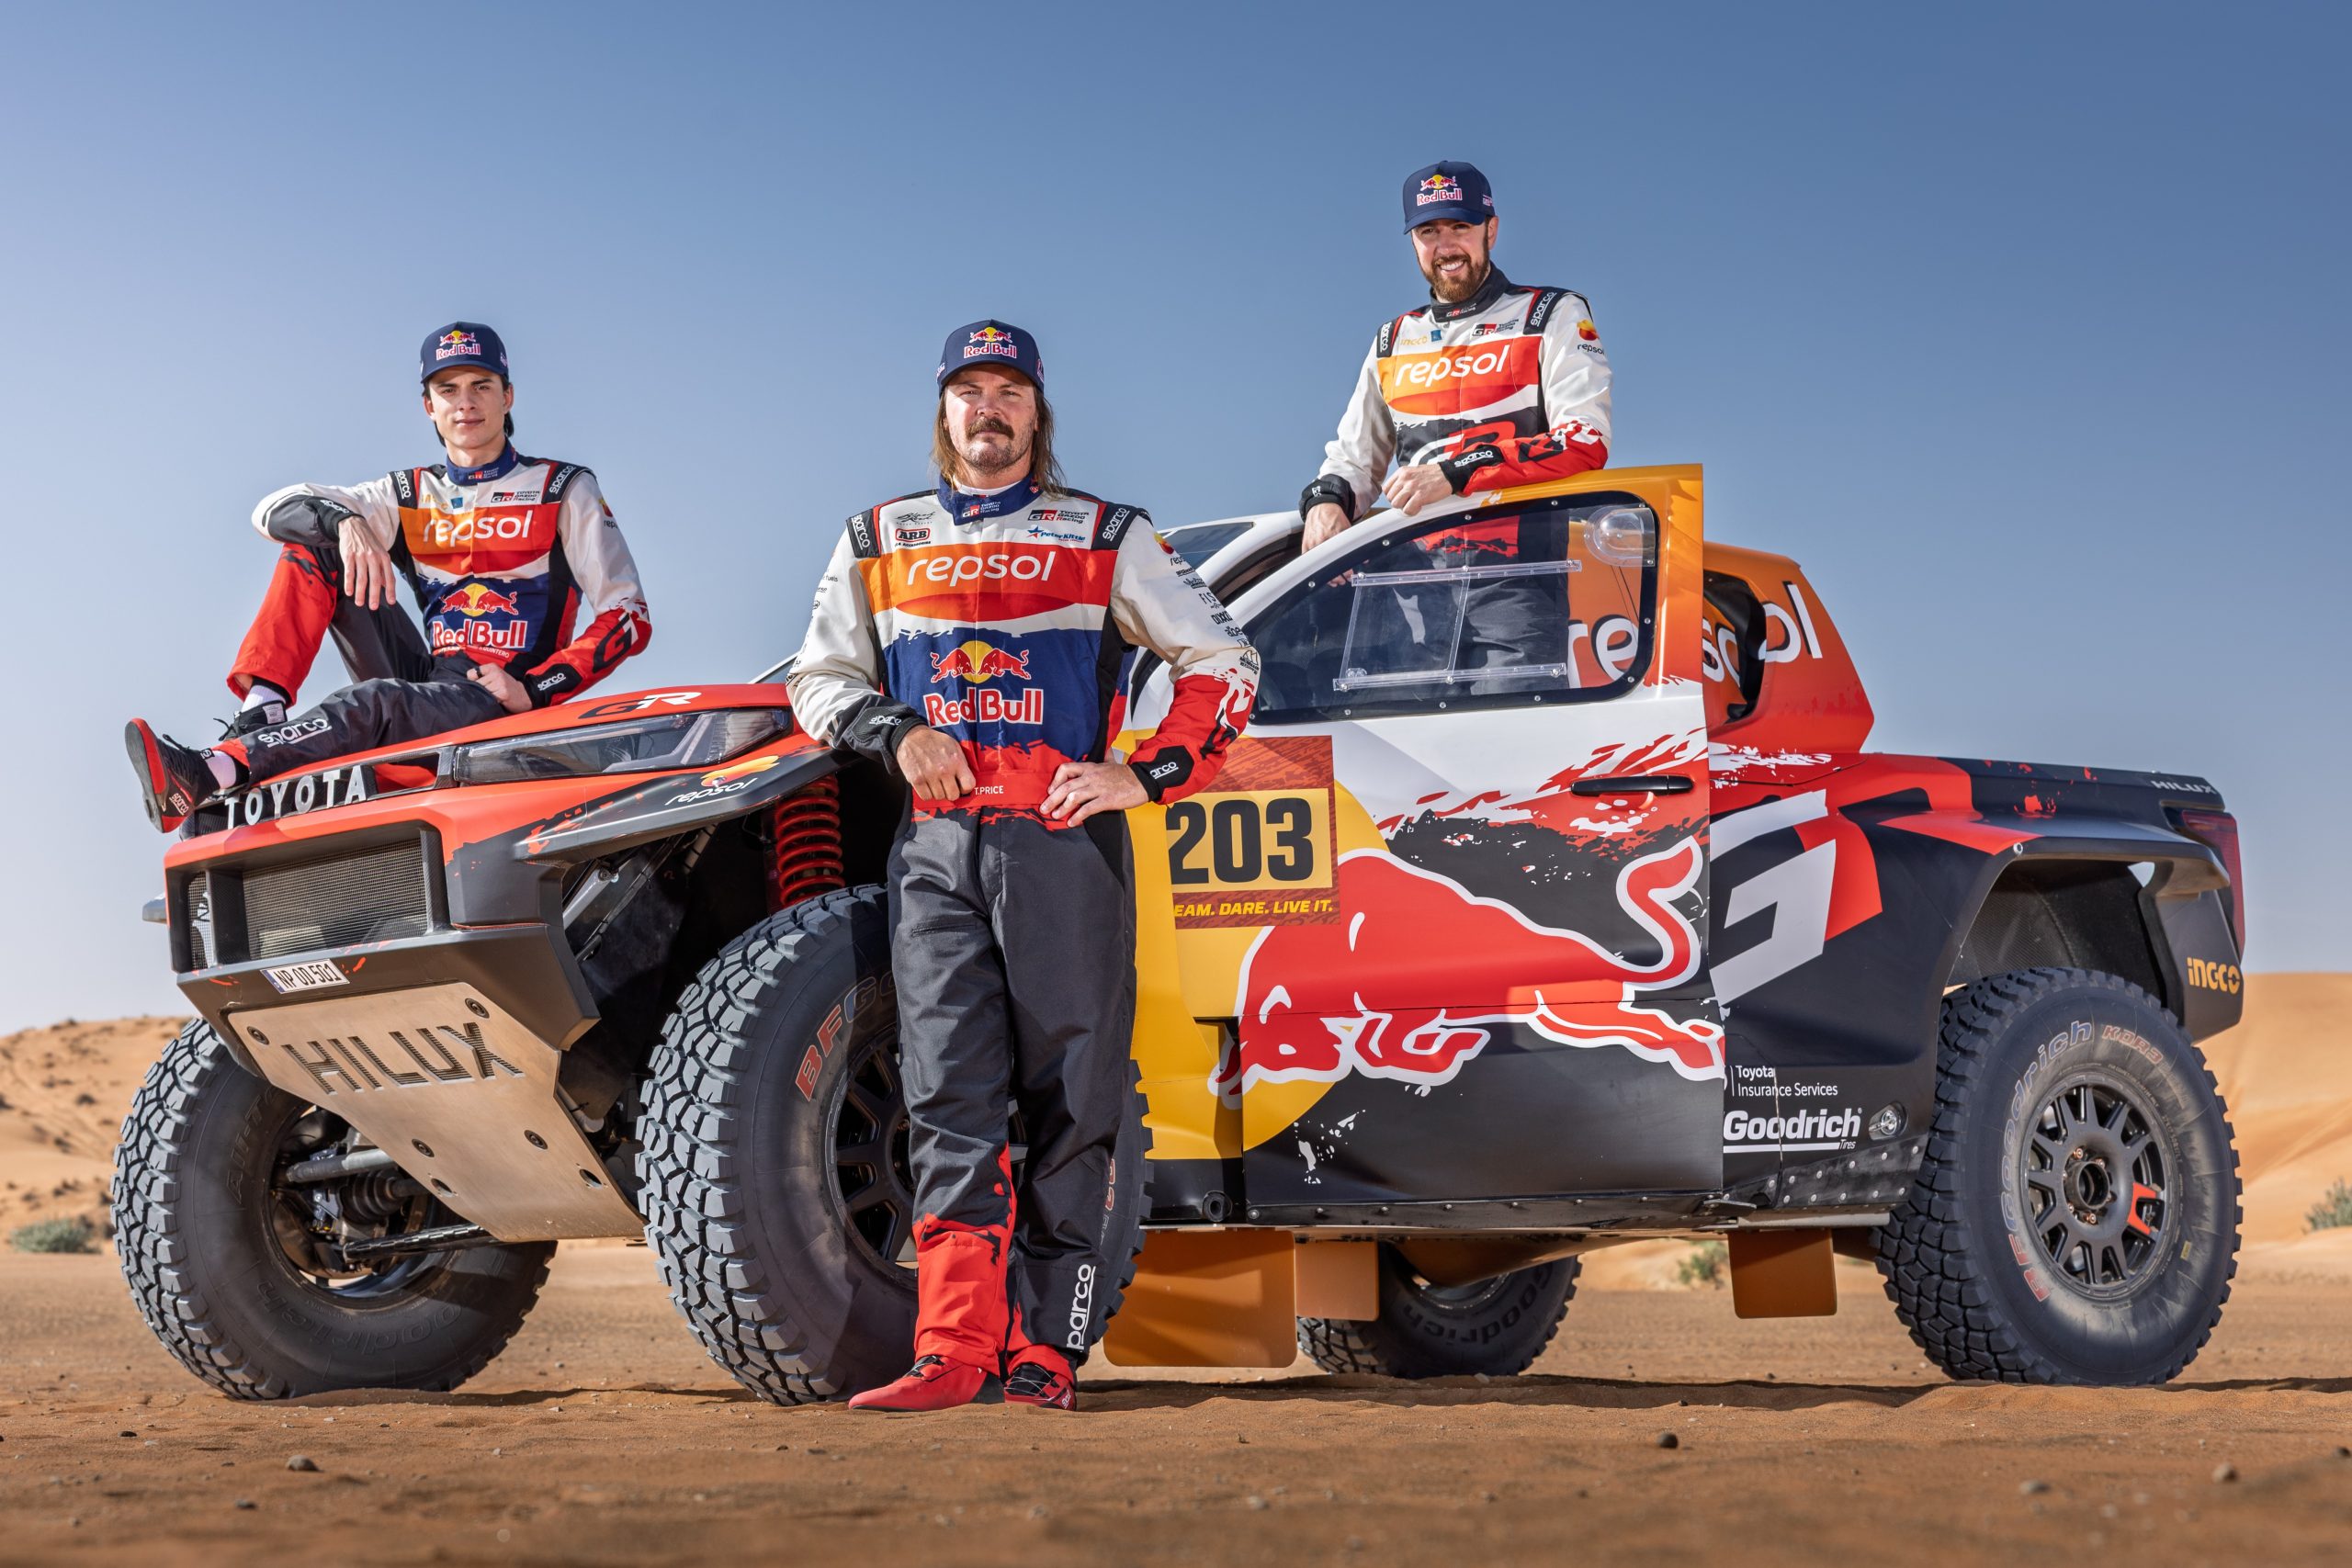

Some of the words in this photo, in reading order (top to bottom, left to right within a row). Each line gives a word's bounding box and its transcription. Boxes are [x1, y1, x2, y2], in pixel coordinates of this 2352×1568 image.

[1417, 190, 1438, 206] Red
[1439, 188, 1463, 201] Bull
[1531, 291, 1556, 327] sparco
[1472, 327, 1496, 336] GR
[435, 344, 457, 360] Red
[458, 344, 481, 356] Bull
[964, 343, 990, 358] Red
[991, 343, 1017, 358] Bull
[1577, 344, 1604, 355] repsol
[1396, 344, 1510, 387] repsol
[1453, 450, 1494, 468] sparco
[548, 465, 577, 494] sparco
[491, 494, 512, 502] GR
[962, 509, 978, 518] GR
[1028, 511, 1057, 521] GR
[1102, 507, 1130, 542] sparco
[424, 510, 534, 547] repsol
[851, 513, 871, 550] sparco
[899, 530, 927, 540] ARB
[907, 551, 1057, 587] repsol
[433, 619, 471, 648] Red
[471, 620, 527, 649] Bull
[579, 692, 702, 719] GR
[922, 687, 977, 728] Red
[978, 688, 1044, 726] Bull
[257, 717, 332, 748] sparco
[1149, 761, 1179, 780] arco
[225, 765, 368, 829] TOYOTA
[665, 778, 759, 806] repsol
[974, 785, 1004, 795] T.PRICE
[2151, 780, 2216, 795] HILUX
[169, 793, 189, 816] sparco
[1165, 797, 1314, 886] 203
[1174, 903, 1216, 918] EAM.
[1219, 901, 1269, 916] DARE.
[1273, 899, 1311, 914] LIVE
[1314, 899, 1333, 912] IT.
[274, 969, 297, 989] NP
[311, 963, 342, 984] 501
[281, 1021, 525, 1096] HILUX
[2102, 1025, 2165, 1065] KDR3
[1736, 1066, 1774, 1081] Toyota
[1737, 1083, 1792, 1098] Insurance
[1794, 1082, 1838, 1097] Services
[1724, 1108, 1861, 1141] Goodrich
[1839, 1139, 1856, 1149] Tires
[1066, 1264, 1097, 1352] parco
[1402, 1262, 1553, 1346] Goodrich
[257, 1280, 462, 1356] oodrich
